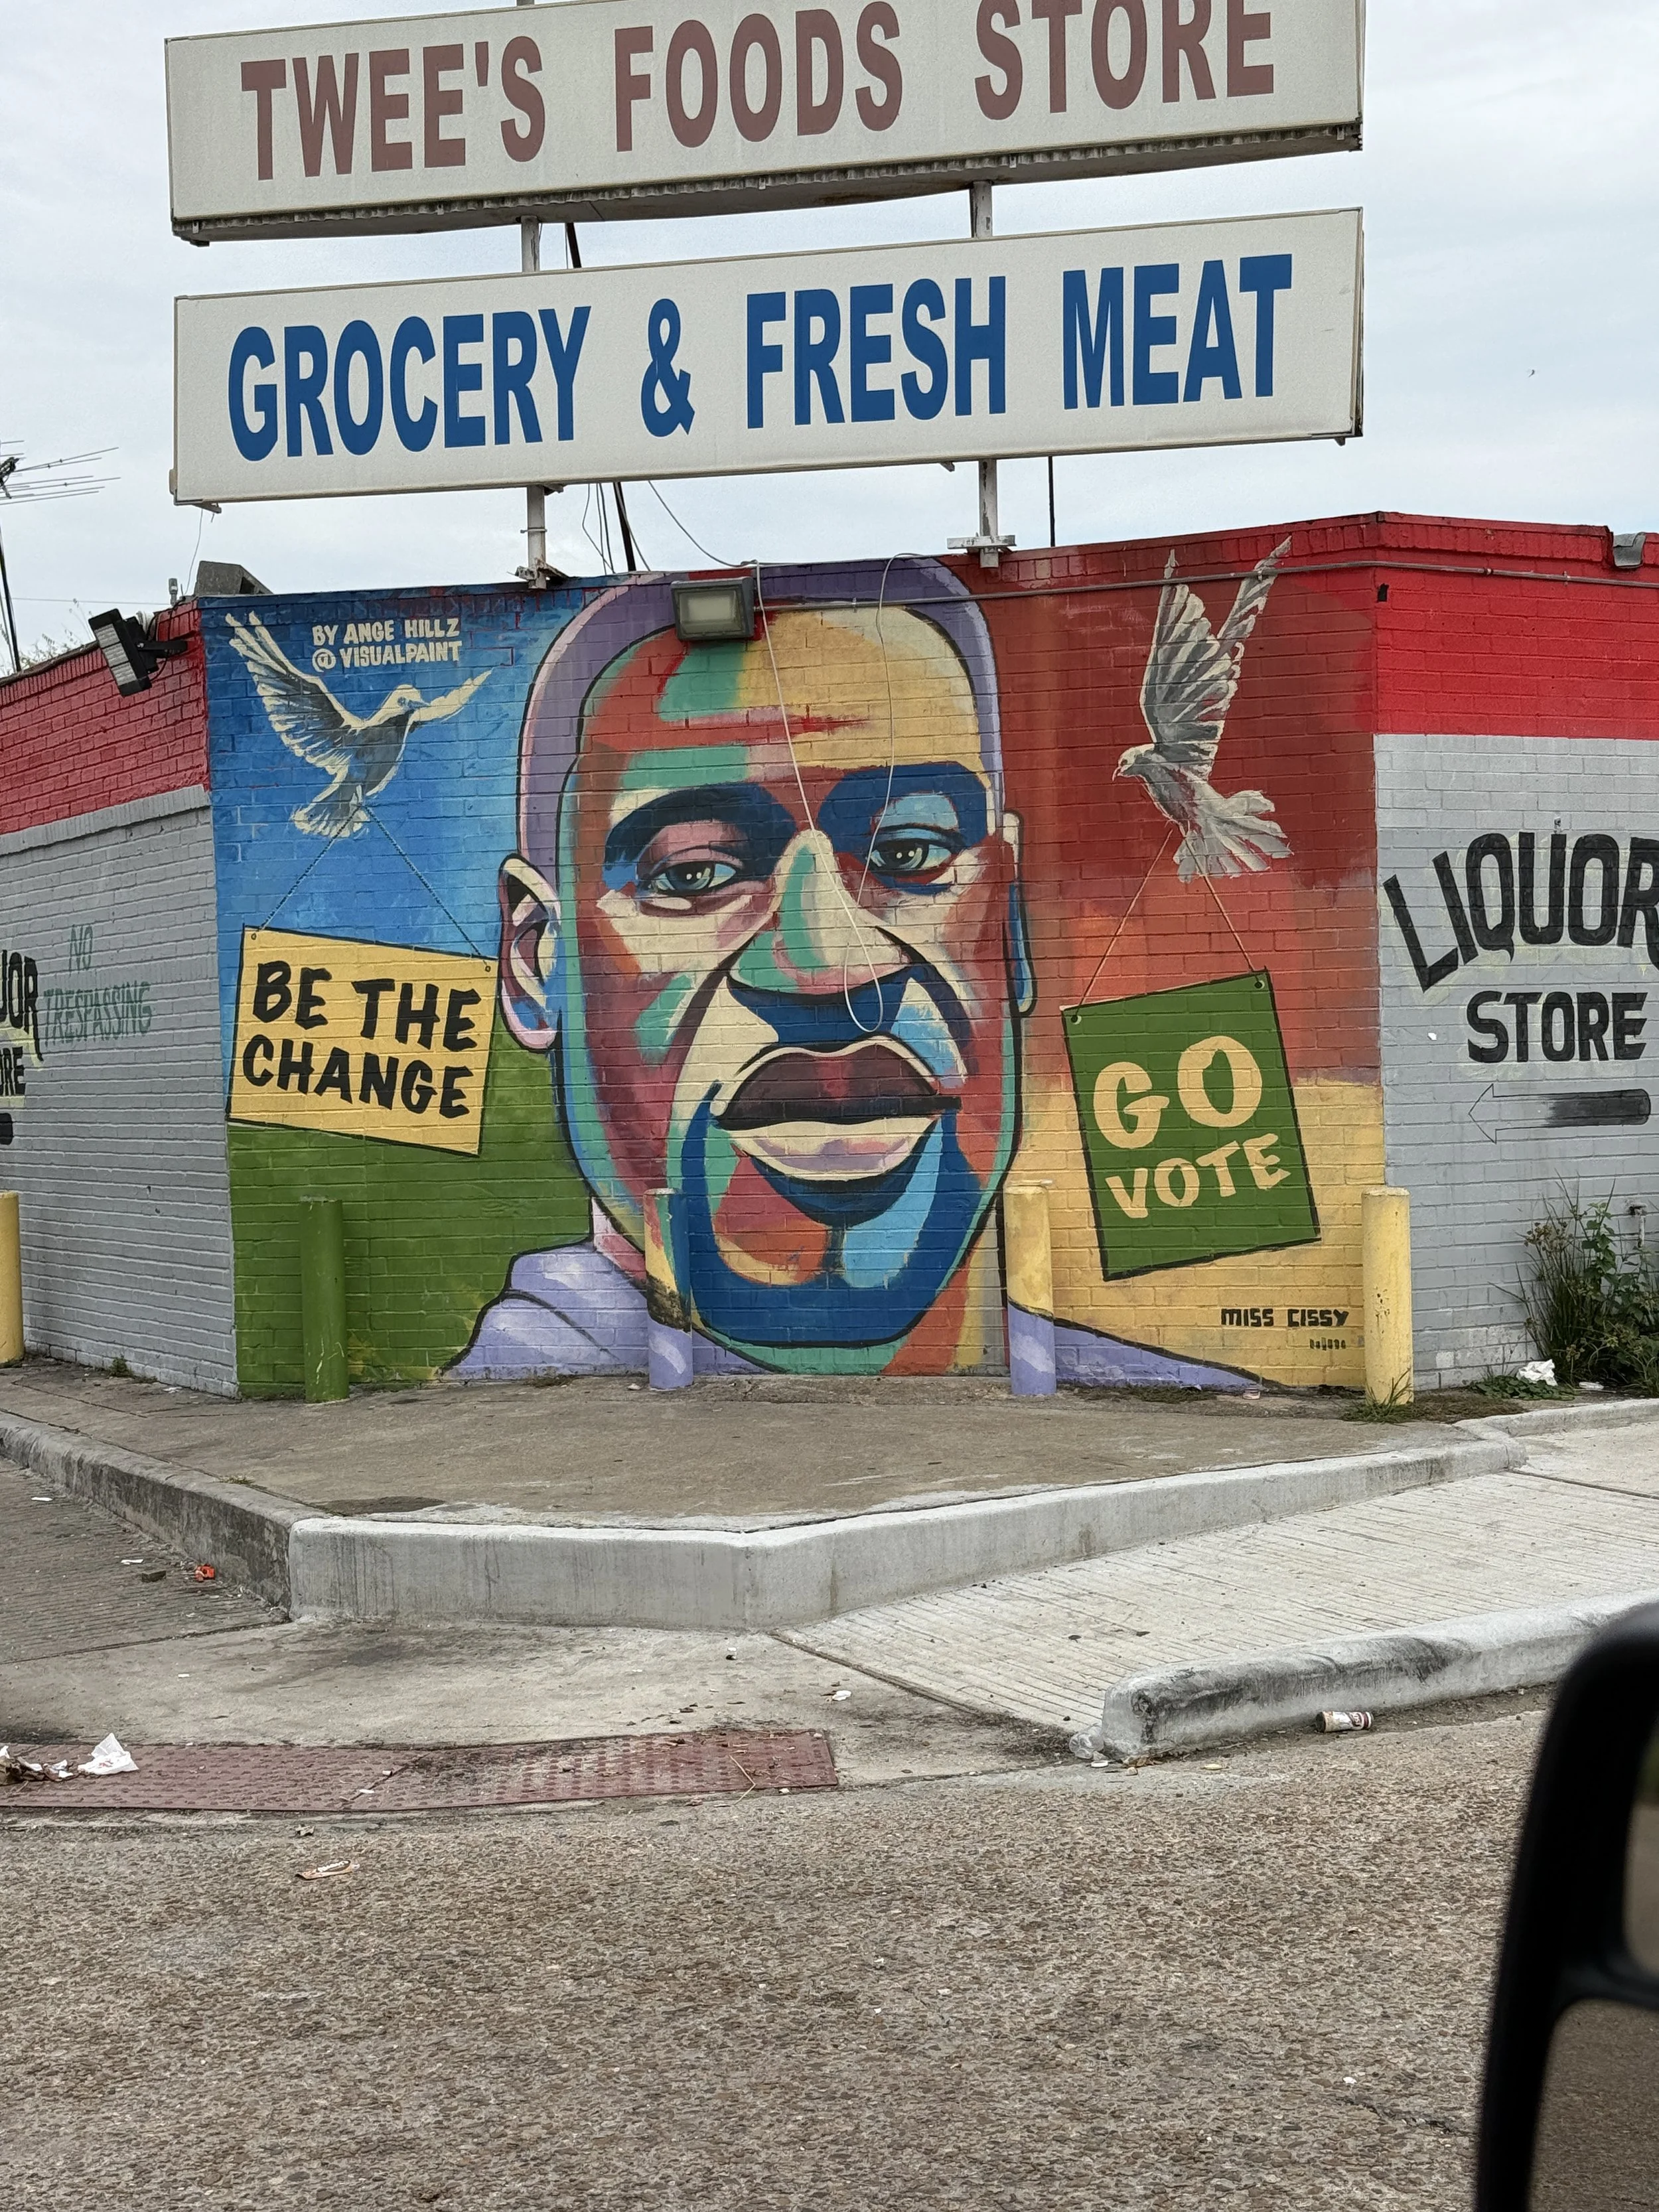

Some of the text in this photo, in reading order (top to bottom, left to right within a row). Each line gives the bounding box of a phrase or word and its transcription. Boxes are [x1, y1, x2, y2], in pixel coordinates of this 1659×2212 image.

[240, 0, 1274, 181] TWEE'S FOODS STORE
[228, 254, 1292, 462] GROCERY & FRESH MEAT
[312, 618, 460, 646] BY ANGE HILLZ
[339, 640, 462, 668] VISUALPAINT
[70, 925, 93, 976] NO
[1383, 832, 1659, 994] LIQUOR
[43, 981, 152, 1047] TRESPASSING
[252, 960, 481, 1052] BE THE
[1466, 990, 1648, 1063] STORE
[243, 1034, 474, 1118] CHANGE
[1093, 1035, 1262, 1149] GO
[1106, 1133, 1291, 1219] VOTE
[1221, 1308, 1349, 1327] MISS CISSY
